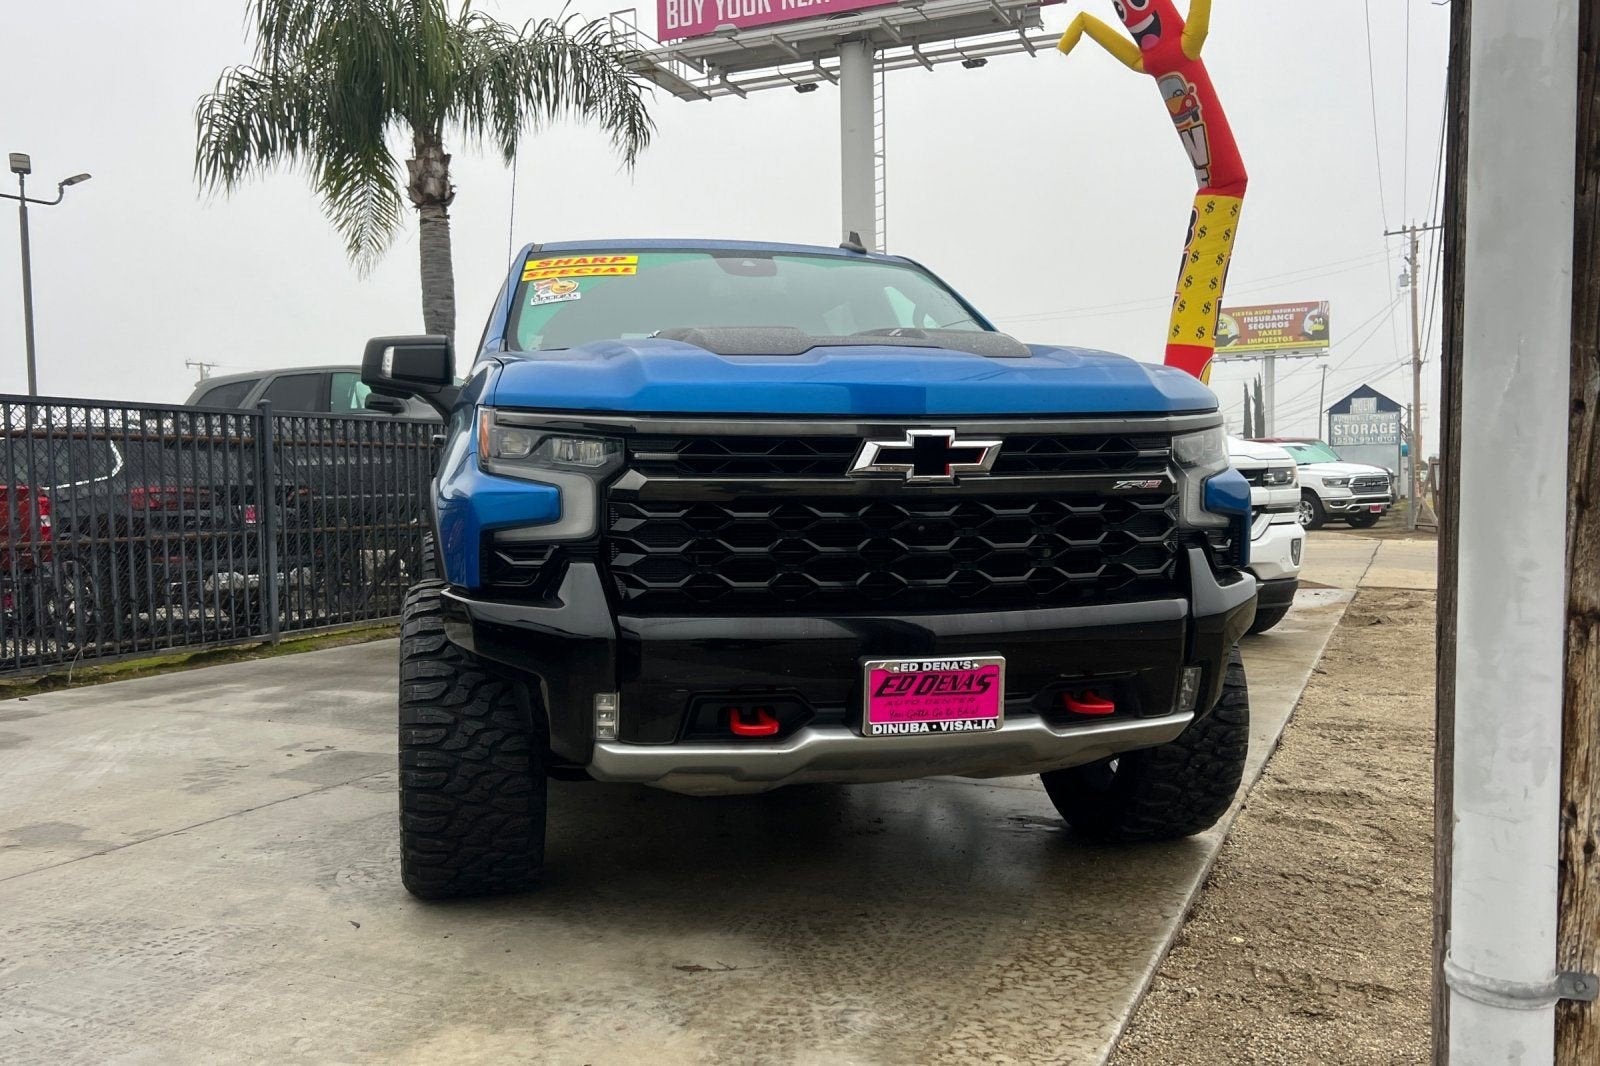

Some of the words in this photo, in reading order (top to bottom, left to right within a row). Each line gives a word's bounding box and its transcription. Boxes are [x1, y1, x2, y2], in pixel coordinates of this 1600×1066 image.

[667, 0, 704, 29] BUY
[537, 256, 627, 267] SHARP
[524, 267, 633, 278] SPECIAL
[1243, 314, 1294, 323] INSURANCE
[1248, 321, 1289, 331] SEGUROS
[1257, 329, 1282, 337] TAXES
[1247, 336, 1294, 344] IMPUESTOS
[1333, 422, 1397, 436] STORAGE
[900, 663, 918, 672] ED
[923, 661, 972, 671] DENA'S
[874, 674, 917, 698] ED
[912, 673, 997, 696] DENA'S
[872, 722, 930, 735] DINUBA
[940, 719, 996, 732] VISALIA
